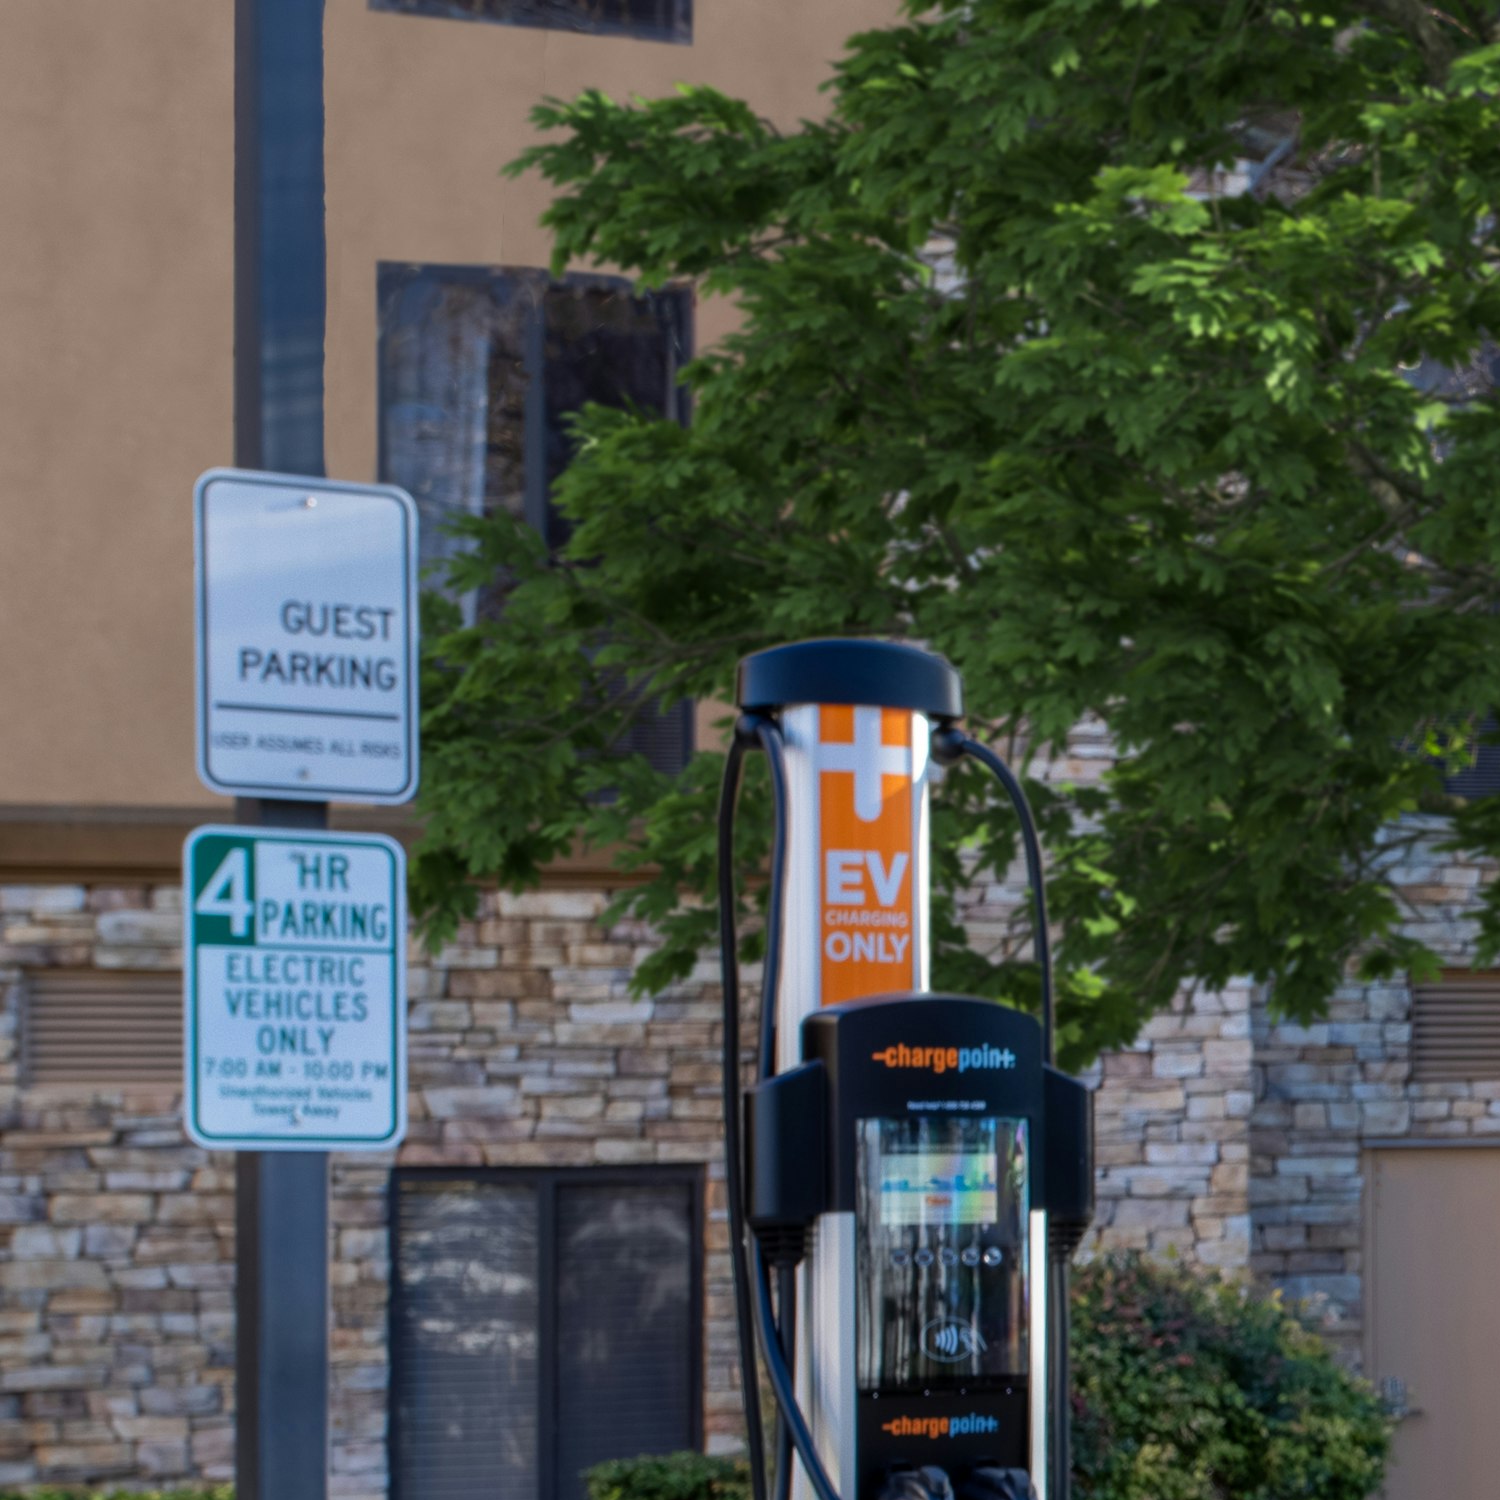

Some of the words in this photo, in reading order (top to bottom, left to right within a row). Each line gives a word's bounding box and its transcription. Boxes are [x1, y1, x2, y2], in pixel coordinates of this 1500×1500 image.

[280, 602, 395, 641] GUEST
[238, 649, 397, 690] PARKING
[196, 847, 253, 938] 4
[297, 853, 350, 891] HR
[826, 851, 908, 906] EV
[262, 902, 389, 942] PARKING
[825, 910, 908, 927] CHARGING
[825, 931, 909, 963] ONLY
[226, 955, 366, 985] ELECTRIC
[225, 991, 368, 1022] VEHICLES
[257, 1025, 335, 1056] ONLY
[256, 1060, 282, 1076] AM
[361, 1061, 388, 1080] PM
